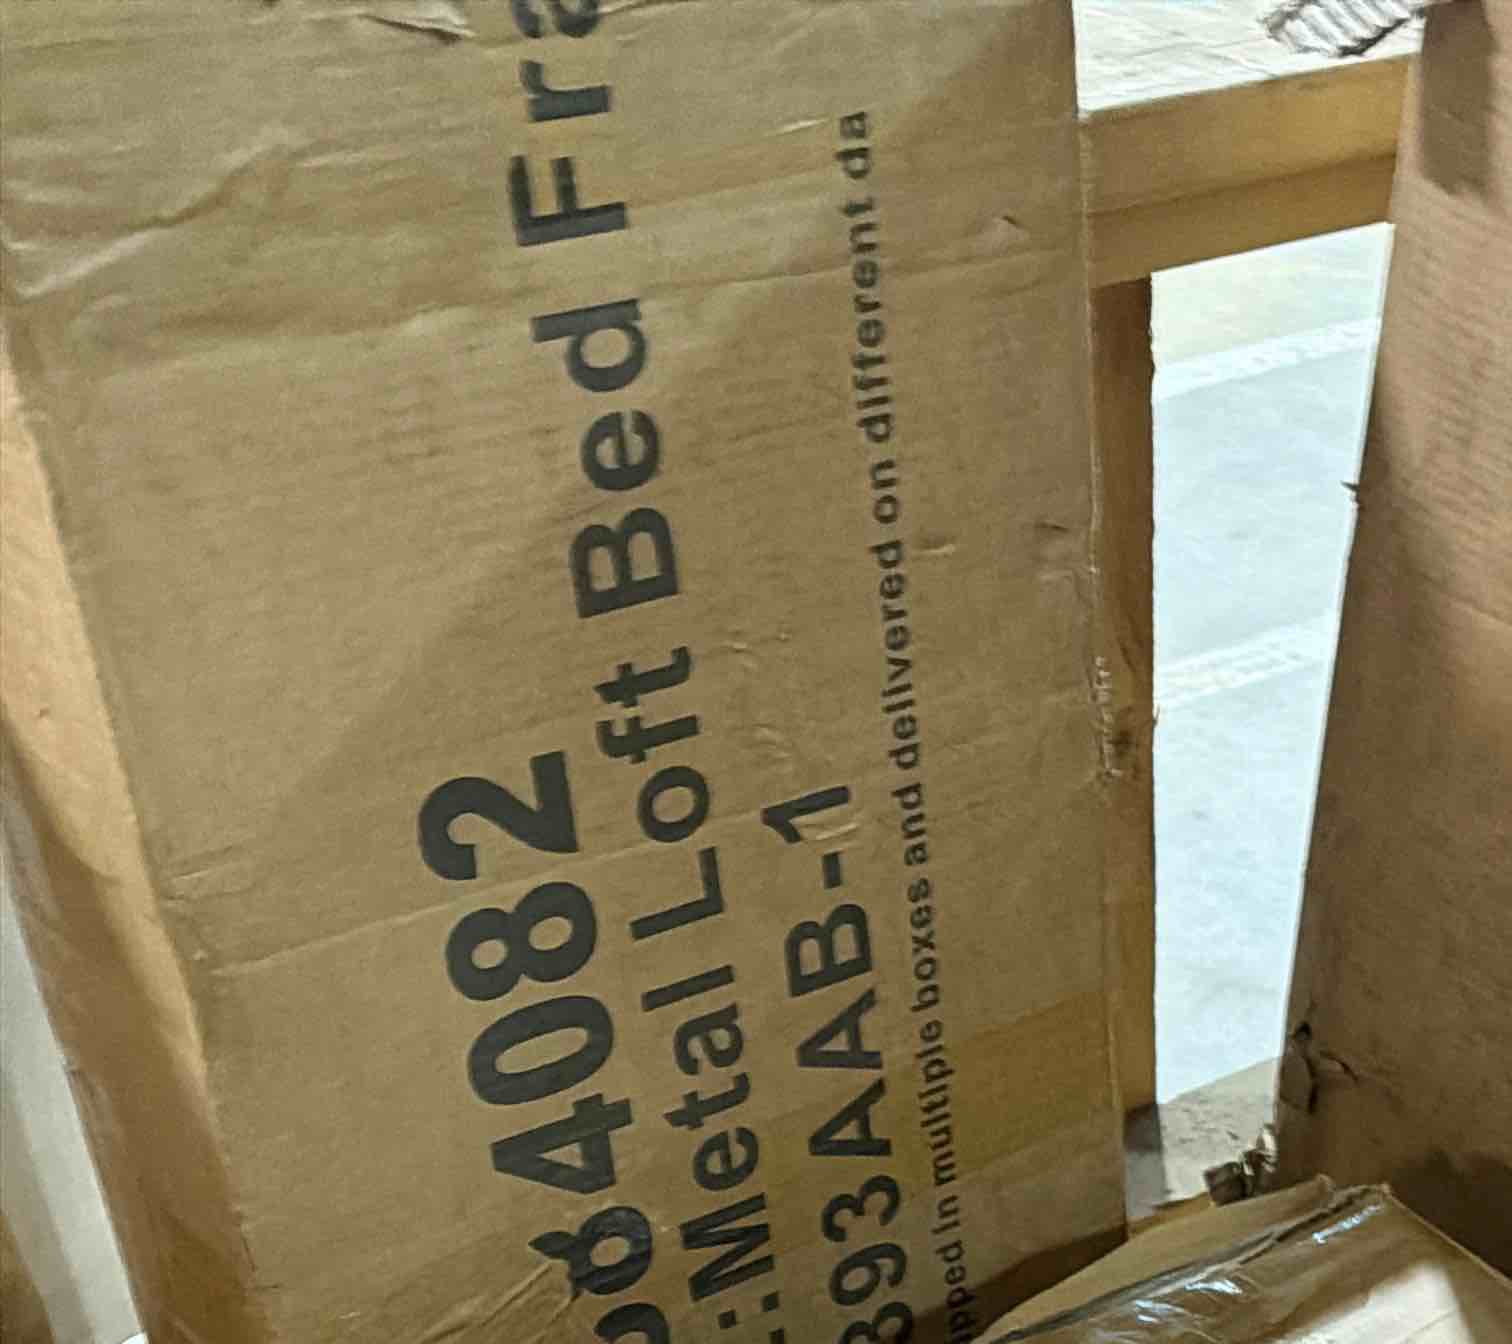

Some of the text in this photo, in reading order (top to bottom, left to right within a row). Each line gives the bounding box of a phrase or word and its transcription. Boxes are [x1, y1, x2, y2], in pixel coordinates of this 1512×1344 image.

[842, 198, 895, 444] different
[531, 297, 680, 619] Bed
[867, 459, 901, 525] on
[868, 538, 922, 770] delivered
[596, 644, 728, 941] Loft
[891, 780, 931, 866] and
[905, 878, 943, 1008] boxes
[915, 1017, 954, 1188] multiple
[931, 1190, 961, 1236] in
